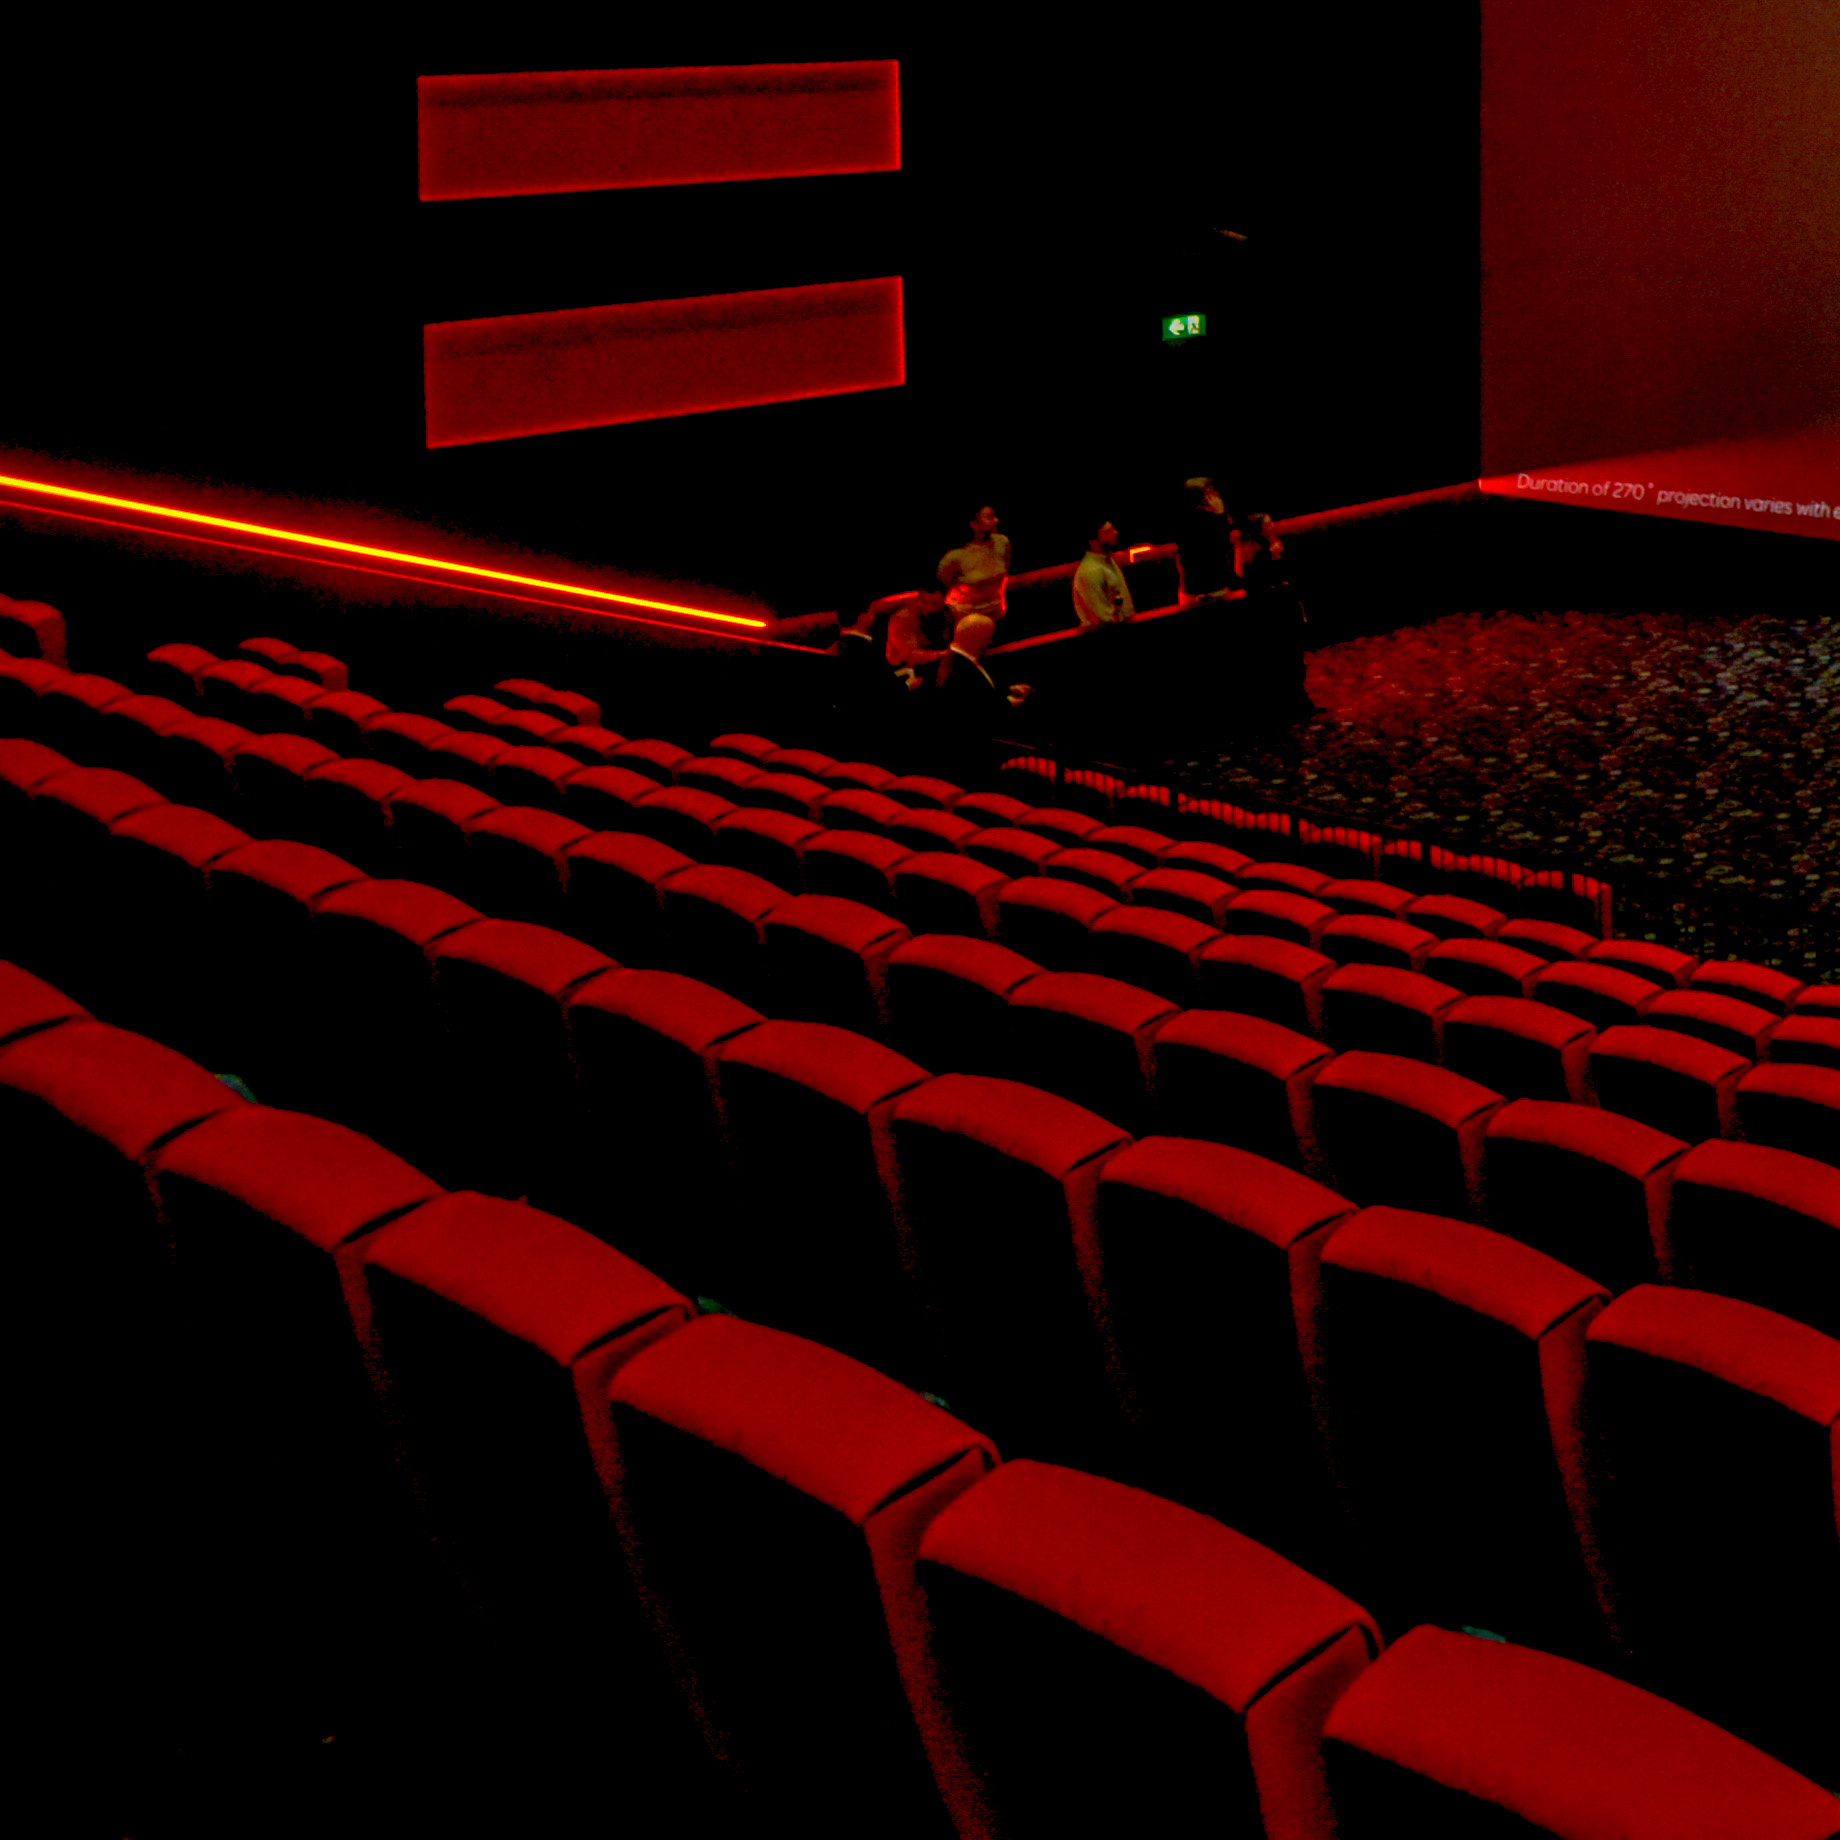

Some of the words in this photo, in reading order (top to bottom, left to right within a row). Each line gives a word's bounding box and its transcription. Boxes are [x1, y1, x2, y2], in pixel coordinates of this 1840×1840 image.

[1517, 473, 1589, 495] Duration
[1591, 480, 1611, 497] of
[1656, 488, 1741, 509] projection
[1743, 497, 1793, 516] varies
[1796, 501, 1831, 519] with
